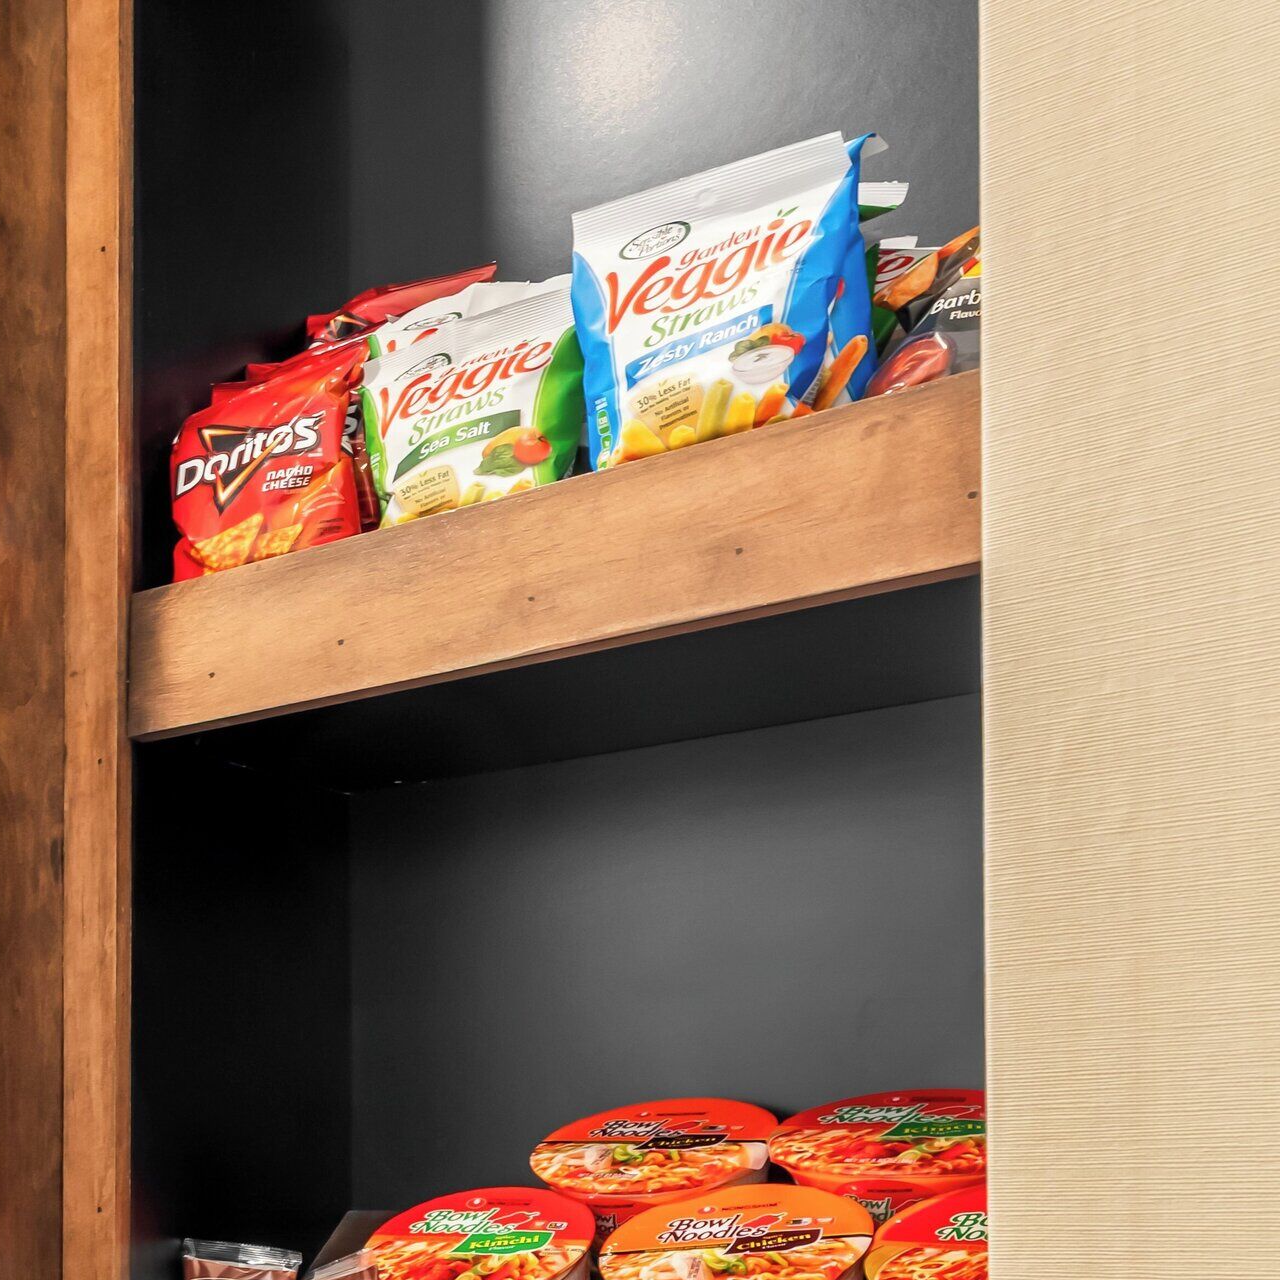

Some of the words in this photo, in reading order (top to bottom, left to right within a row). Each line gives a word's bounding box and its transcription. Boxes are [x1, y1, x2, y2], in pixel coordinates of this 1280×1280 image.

[673, 222, 761, 270] garden
[604, 217, 813, 335] Veggie
[929, 289, 981, 315] Barb
[643, 279, 761, 349] Straws
[637, 338, 696, 376] Zesty
[698, 313, 760, 349] Ranch
[379, 340, 553, 441] Veggie
[408, 386, 506, 447] Straws
[418, 434, 450, 460] Sea
[454, 420, 492, 443] Salt
[175, 410, 326, 498] Doritos
[265, 464, 314, 480] NACHO
[261, 476, 311, 492] CHEESE
[819, 1111, 955, 1125] Noodles
[835, 1103, 928, 1116] Bowl
[589, 1125, 687, 1139] Noodles
[603, 1118, 670, 1132] Bowl
[423, 1206, 500, 1223] Bowl
[667, 1213, 744, 1232] Bowl
[408, 1219, 516, 1235] Noodles
[656, 1225, 770, 1244] Noodles
[468, 1234, 541, 1251] Kimchi
[736, 1231, 812, 1251] Chicken
